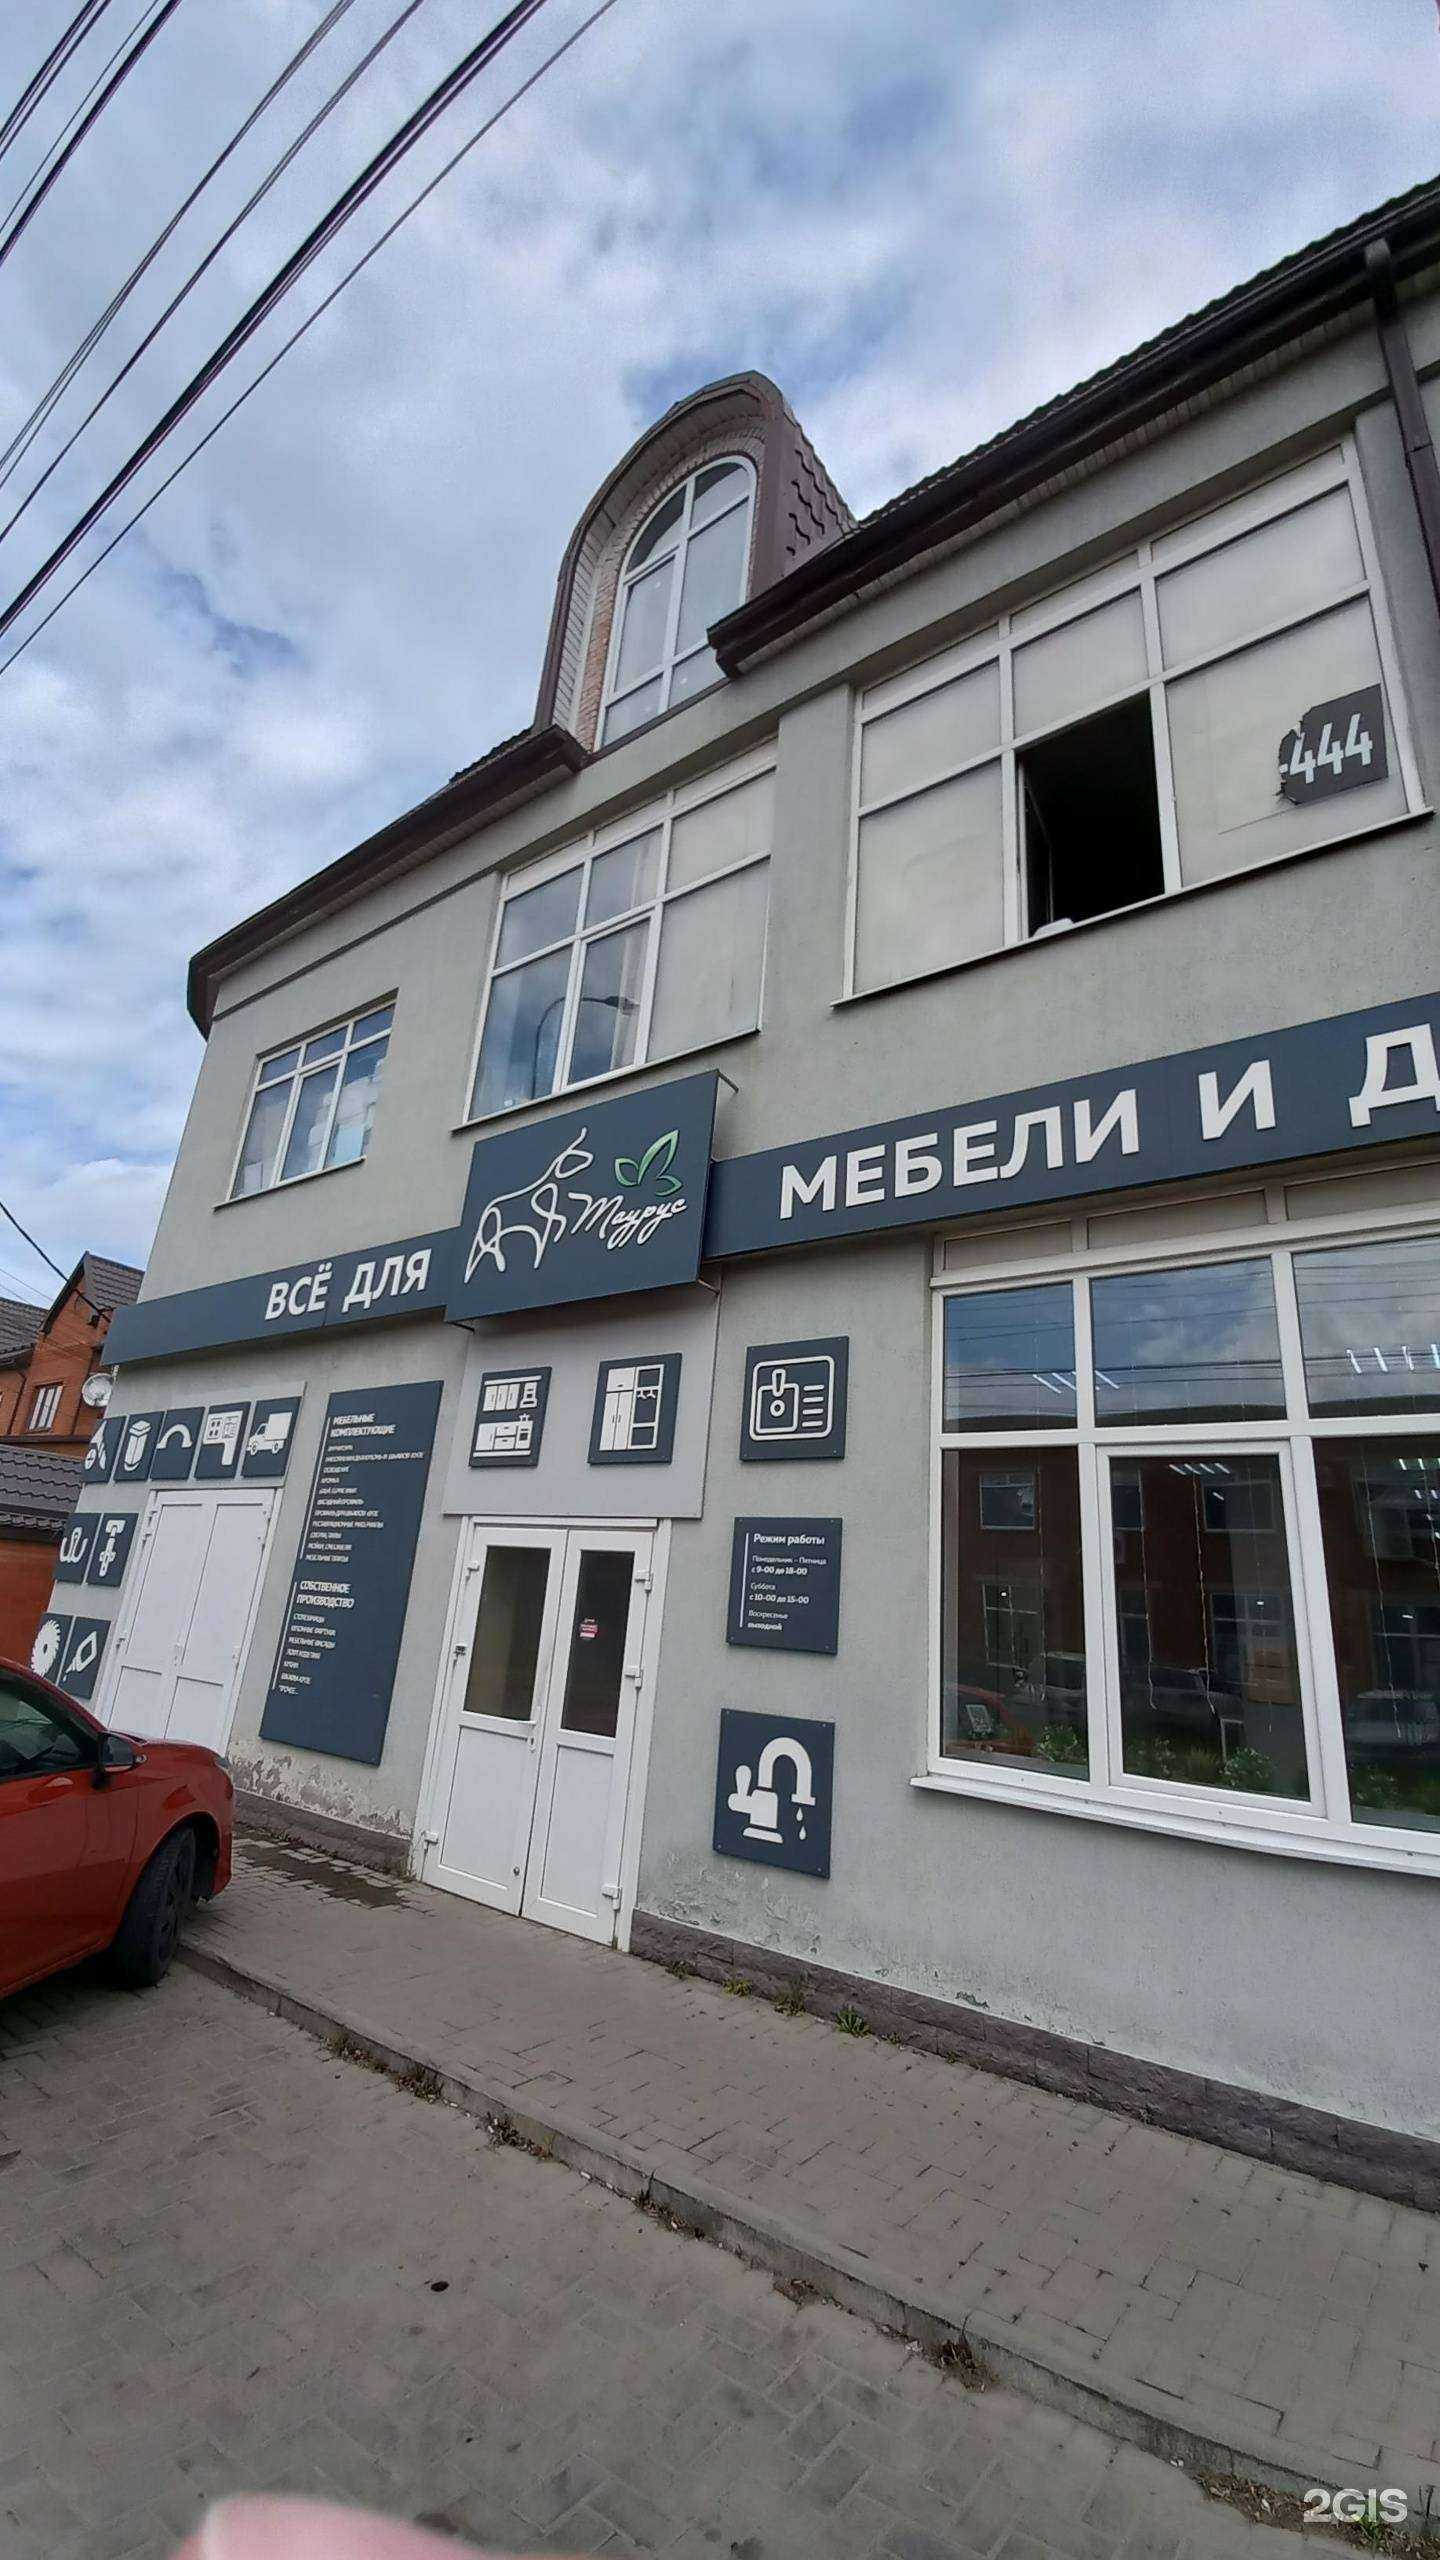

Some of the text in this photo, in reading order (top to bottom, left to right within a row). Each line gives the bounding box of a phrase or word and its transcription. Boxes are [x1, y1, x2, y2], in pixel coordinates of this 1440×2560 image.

[780, 1089, 1140, 1219] МЕБЕЛИ
[1198, 1059, 1276, 1140] И
[265, 1248, 432, 1321] ВСЁ ДЛЯ
[753, 1533, 825, 1546] Режим работы
[754, 1593, 777, 1602] 10-00
